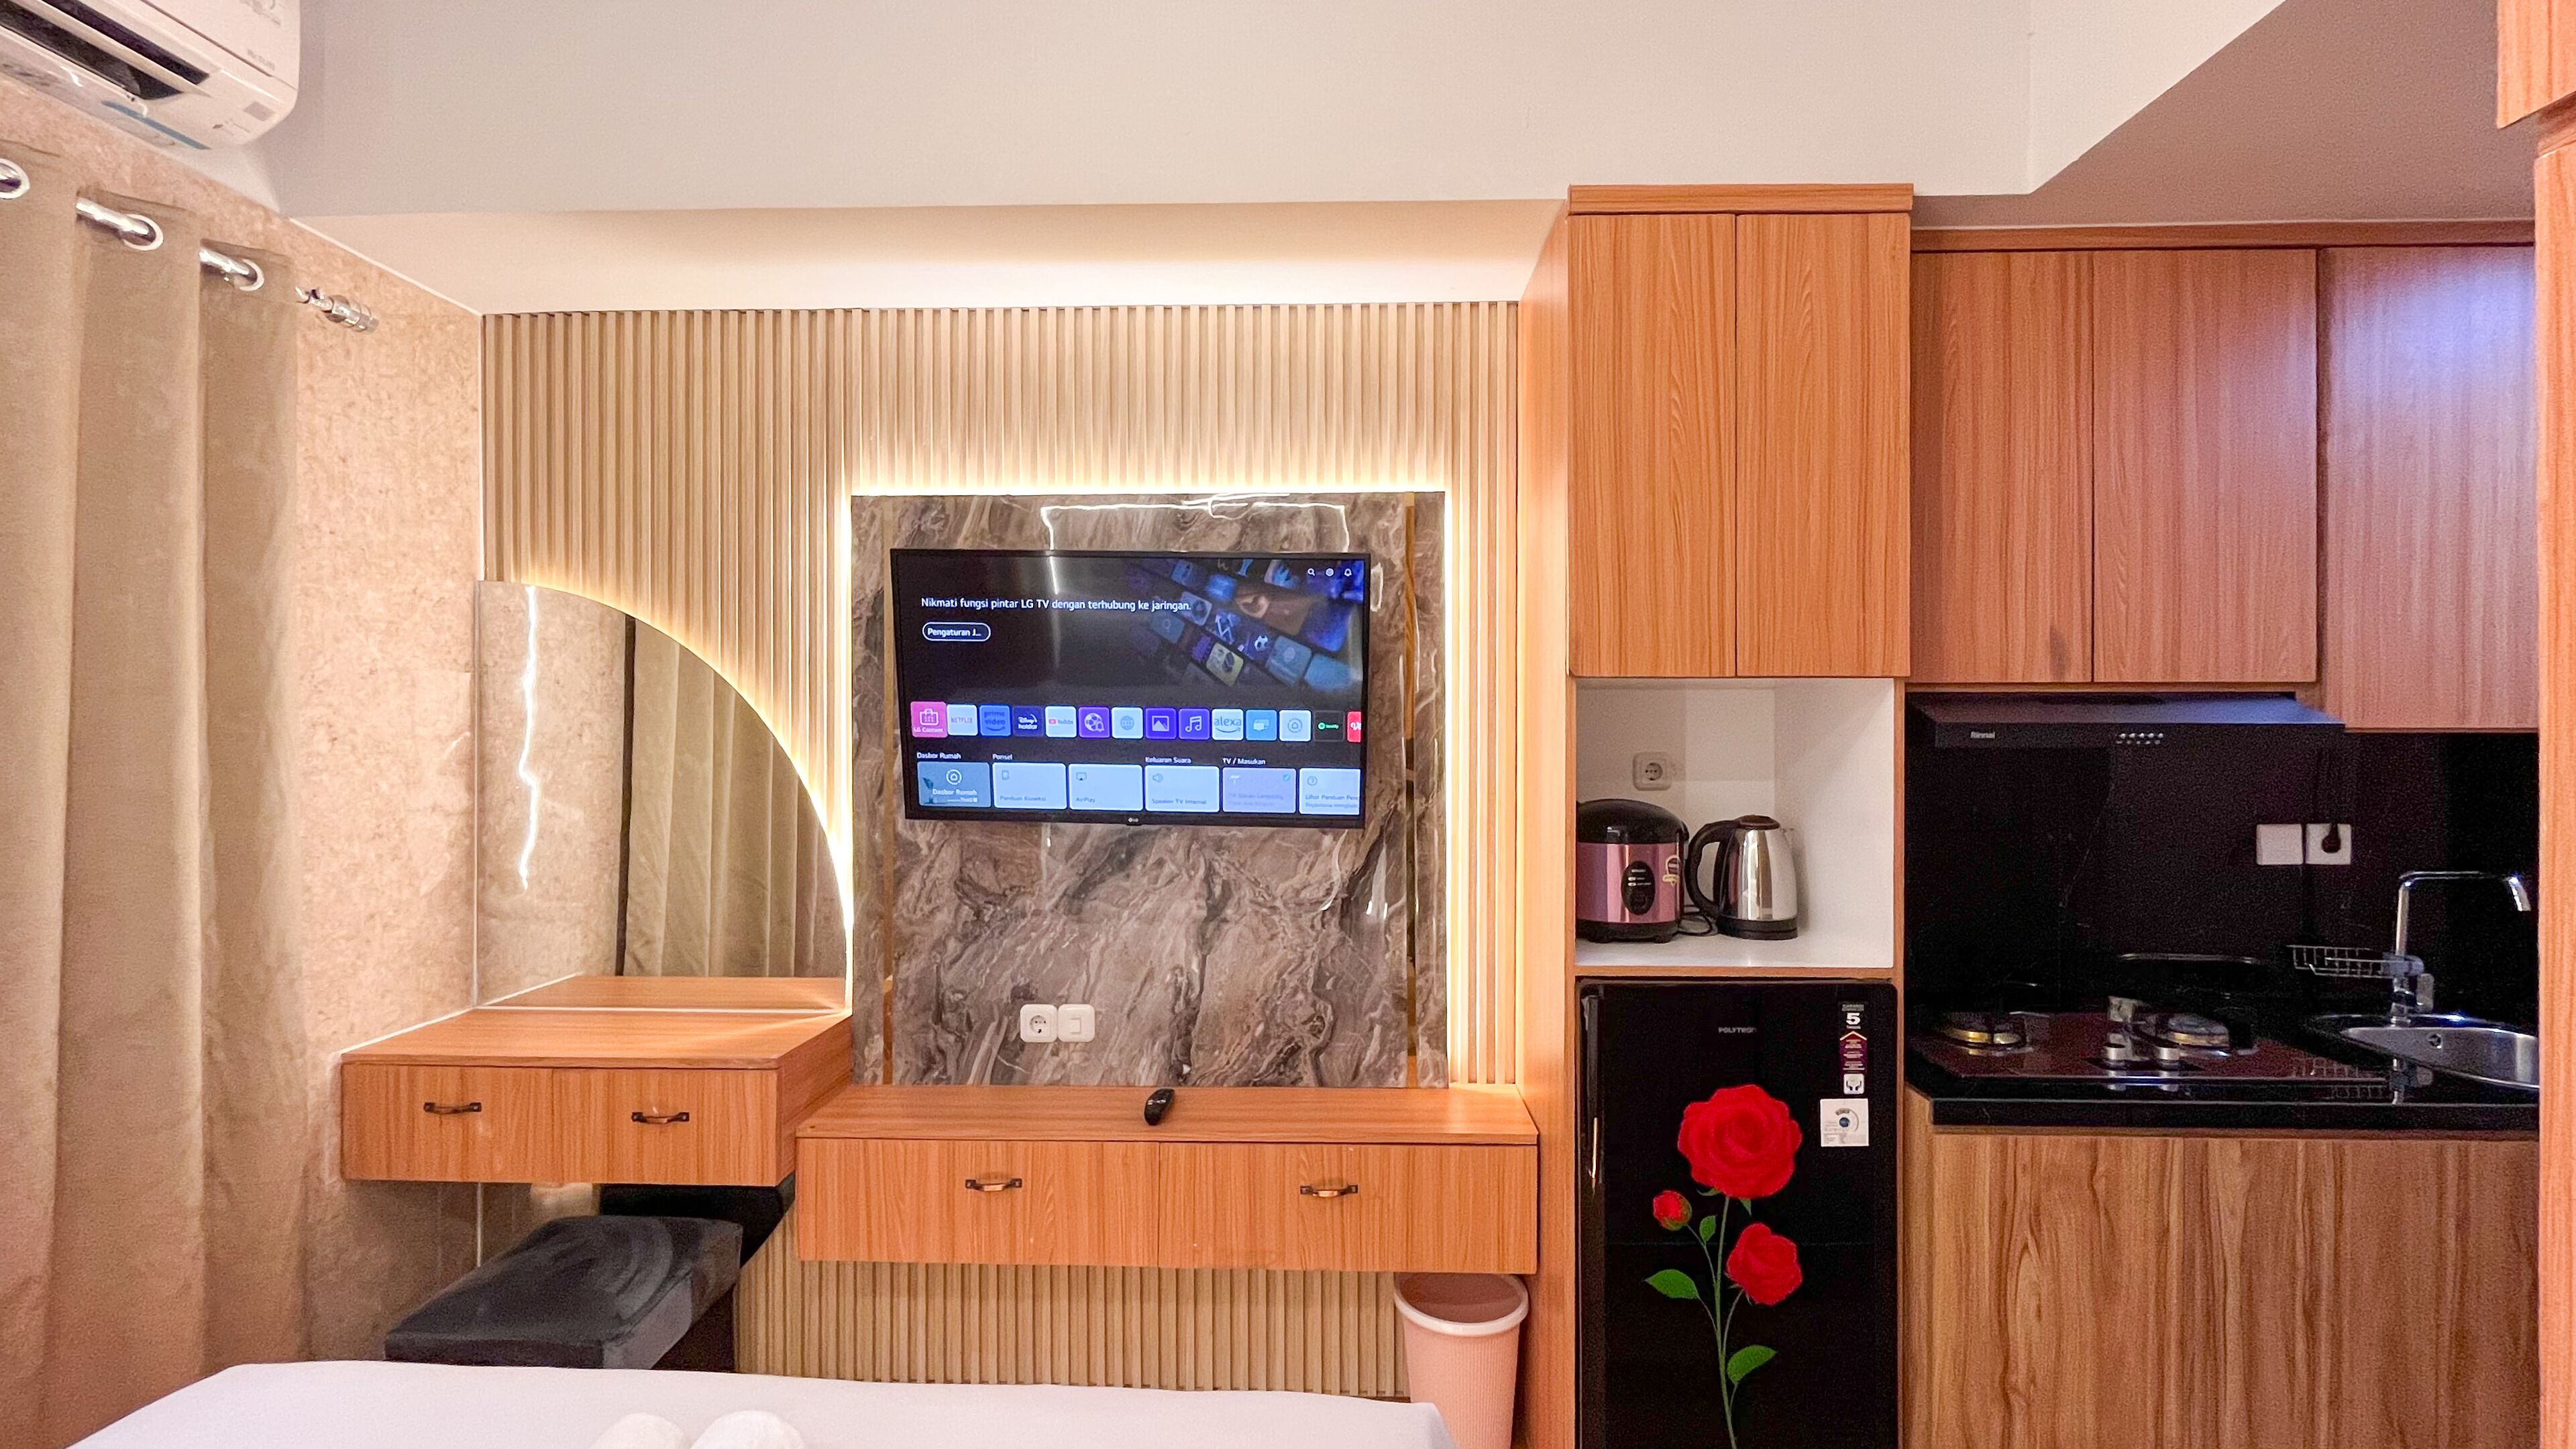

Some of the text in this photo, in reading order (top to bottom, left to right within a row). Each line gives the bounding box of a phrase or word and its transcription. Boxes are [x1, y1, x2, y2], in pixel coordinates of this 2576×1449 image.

[921, 598, 1191, 612] Nikmati fungsi pintar LG TV dengan terhubung ke jaringan.
[927, 627, 970, 637] Pengaturan
[1214, 716, 1241, 727] alexa
[1846, 1012, 1860, 1025] 5
